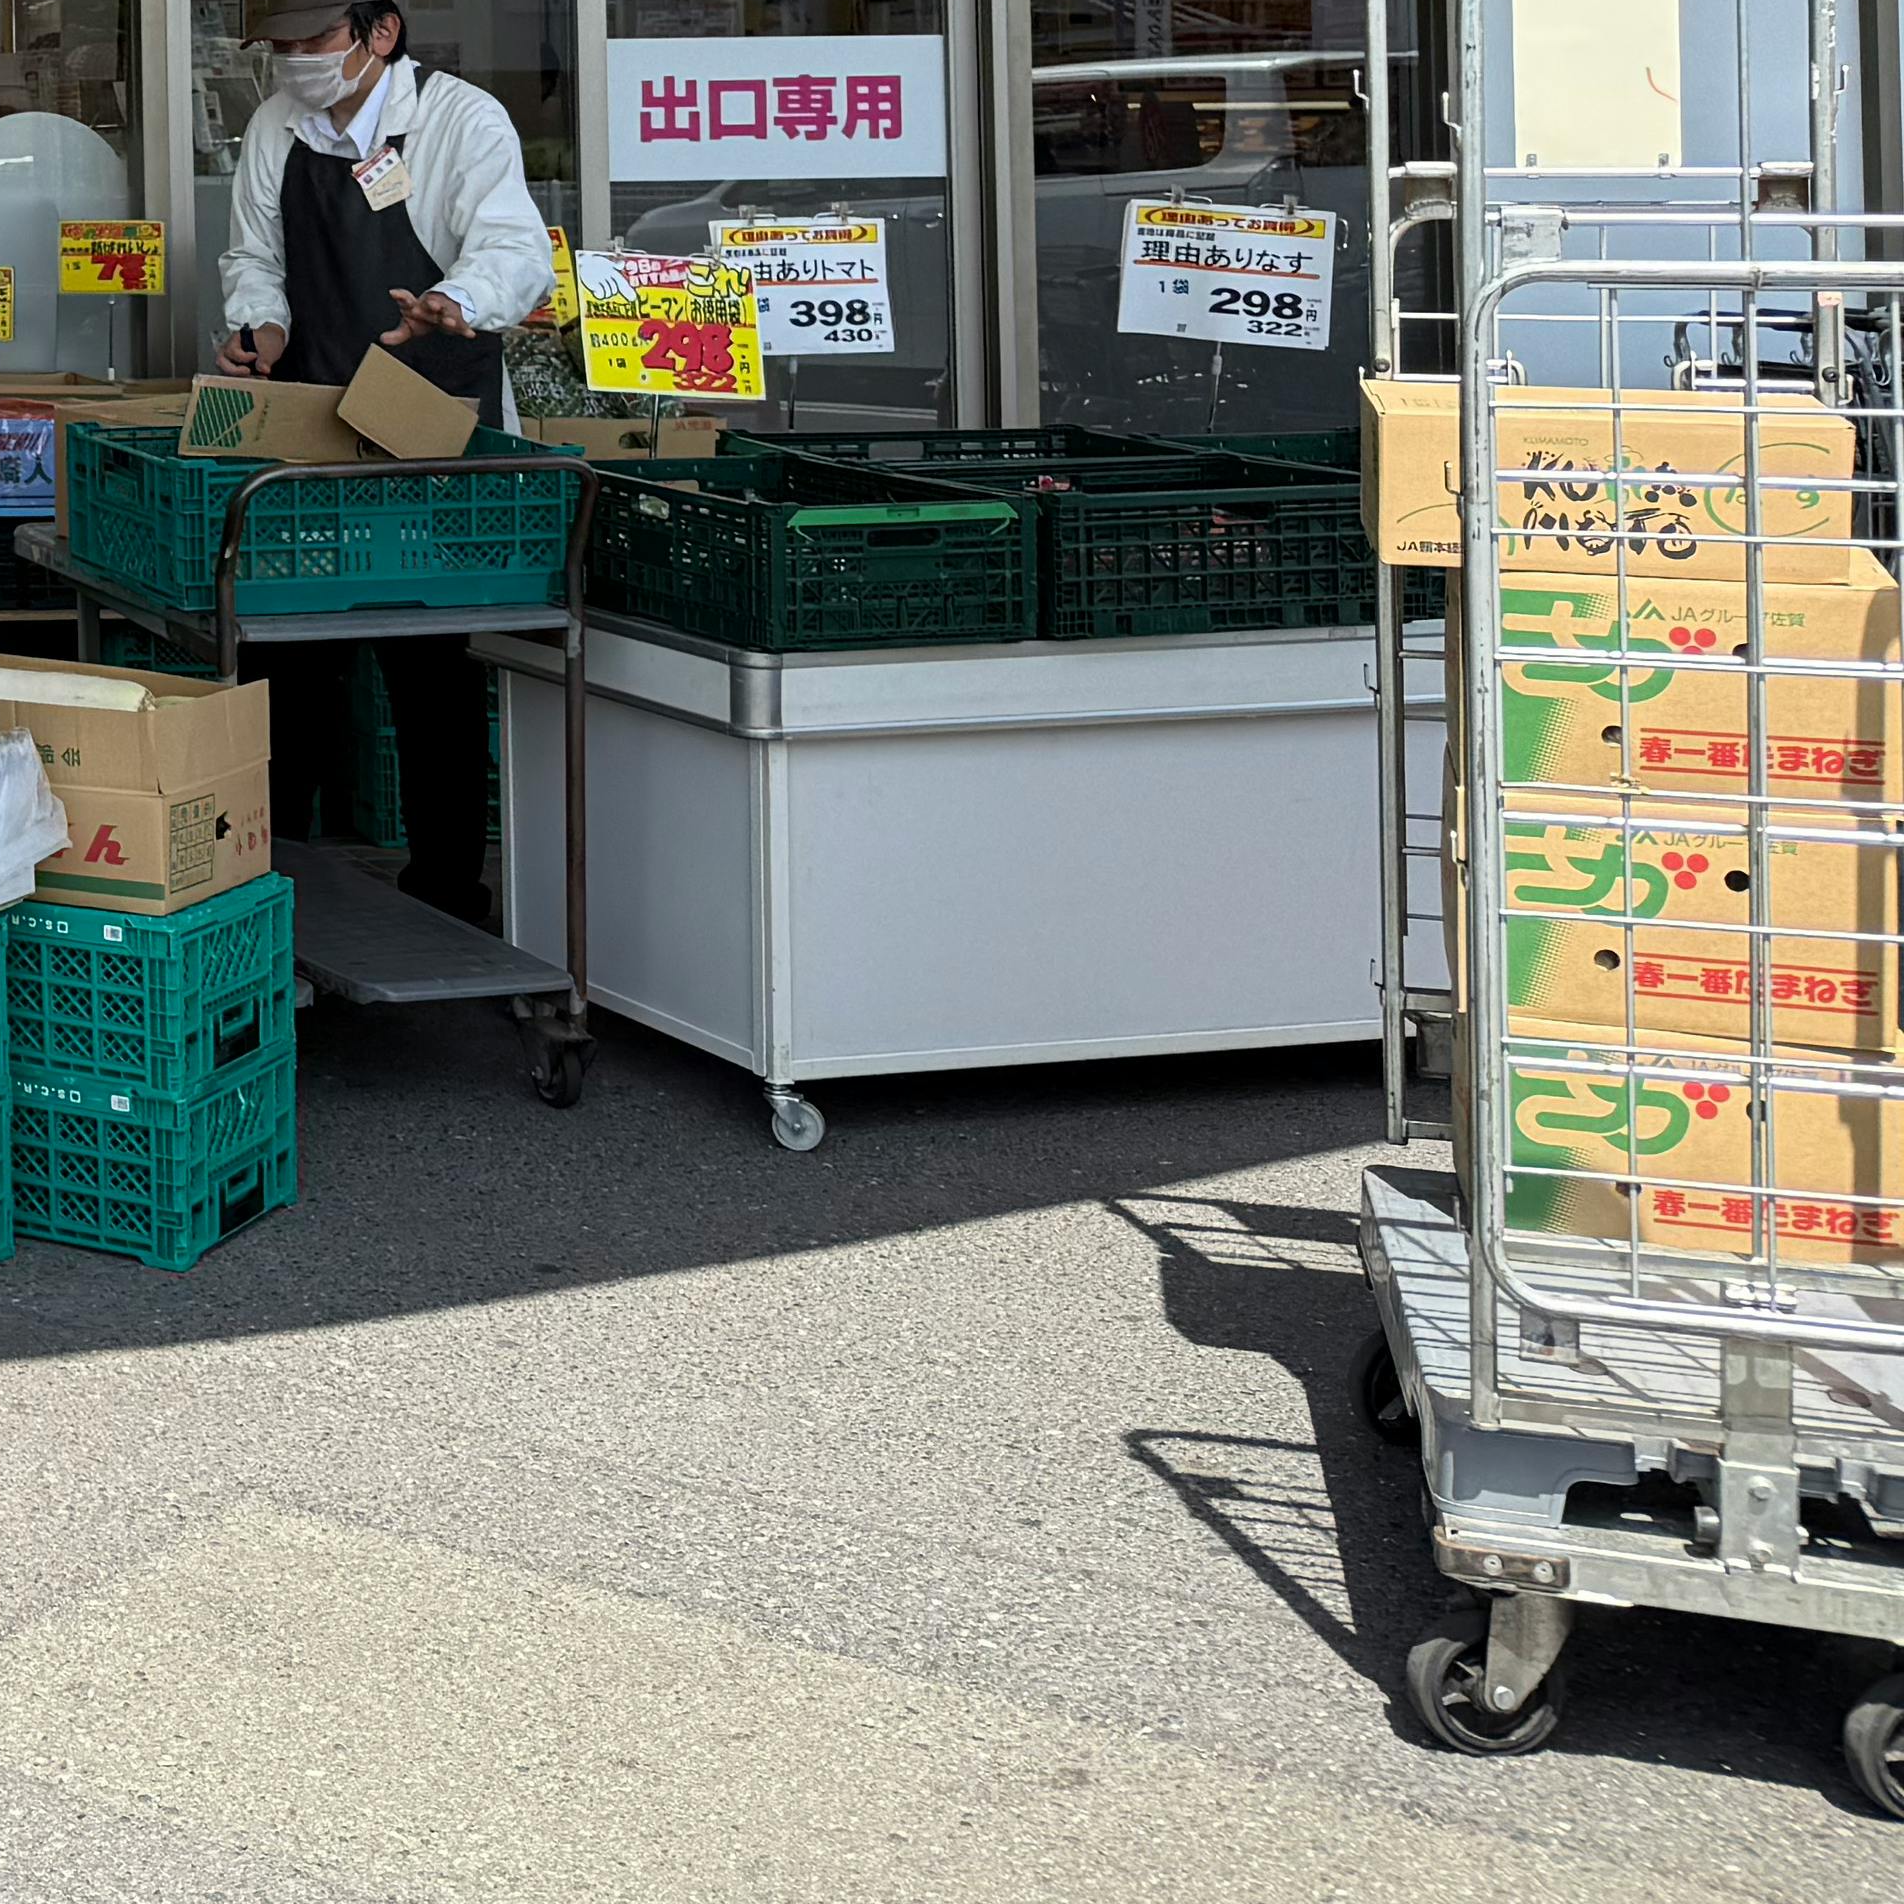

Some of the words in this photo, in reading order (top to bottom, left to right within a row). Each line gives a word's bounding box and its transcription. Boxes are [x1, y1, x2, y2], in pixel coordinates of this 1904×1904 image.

[639, 73, 903, 143] 出口専用
[732, 258, 875, 282] 由ありトマト
[1141, 240, 1314, 274] 理由ありなす
[789, 299, 872, 327] 398
[1208, 287, 1304, 320] 298
[823, 328, 873, 343] 430
[1246, 319, 1303, 337] 322
[638, 320, 734, 374] 298
[1521, 436, 1589, 447] KUMAMOTO
